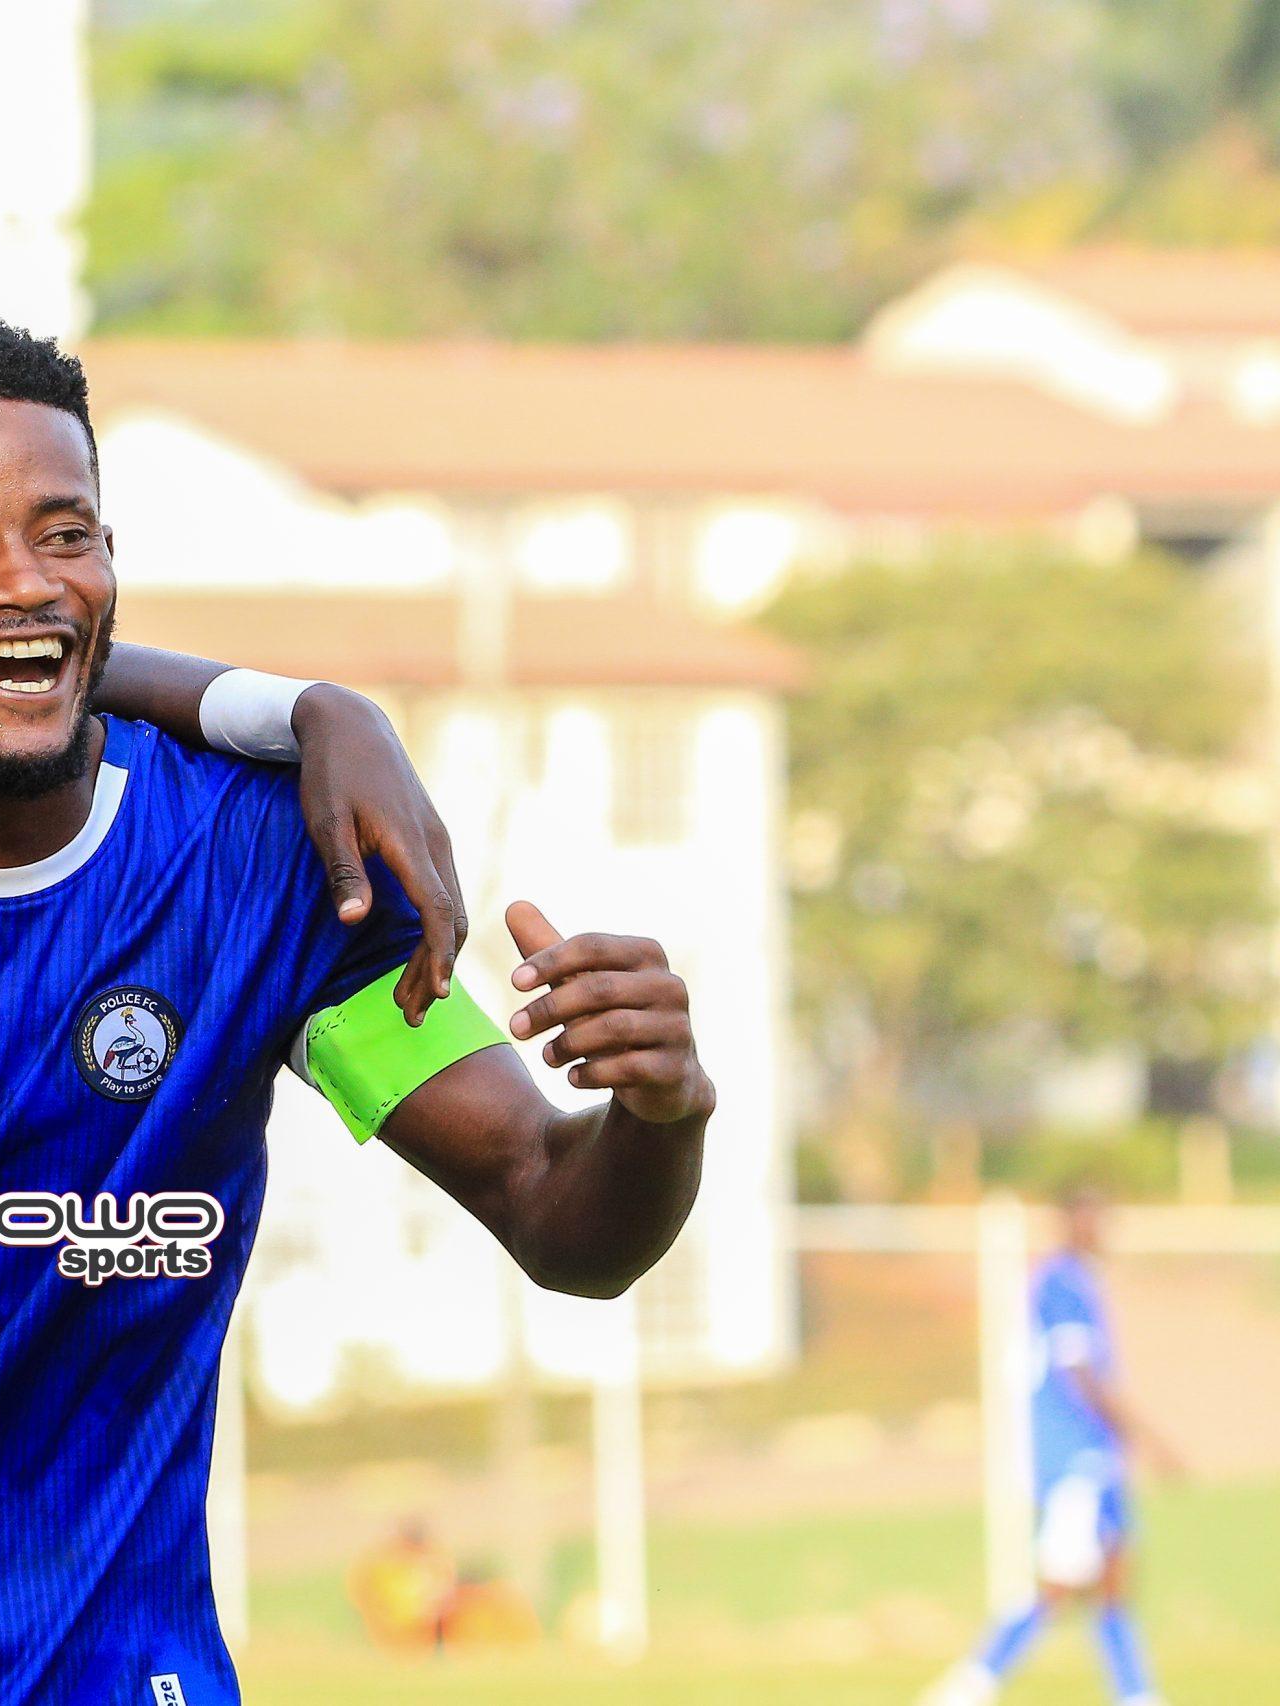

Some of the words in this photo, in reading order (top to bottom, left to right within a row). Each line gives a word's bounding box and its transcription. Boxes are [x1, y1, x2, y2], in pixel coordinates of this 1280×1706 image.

[99, 993, 141, 1013] POLICE
[142, 997, 158, 1012] FC
[100, 1076, 123, 1094] Play
[124, 1085, 135, 1093] to
[137, 1074, 163, 1092] serve
